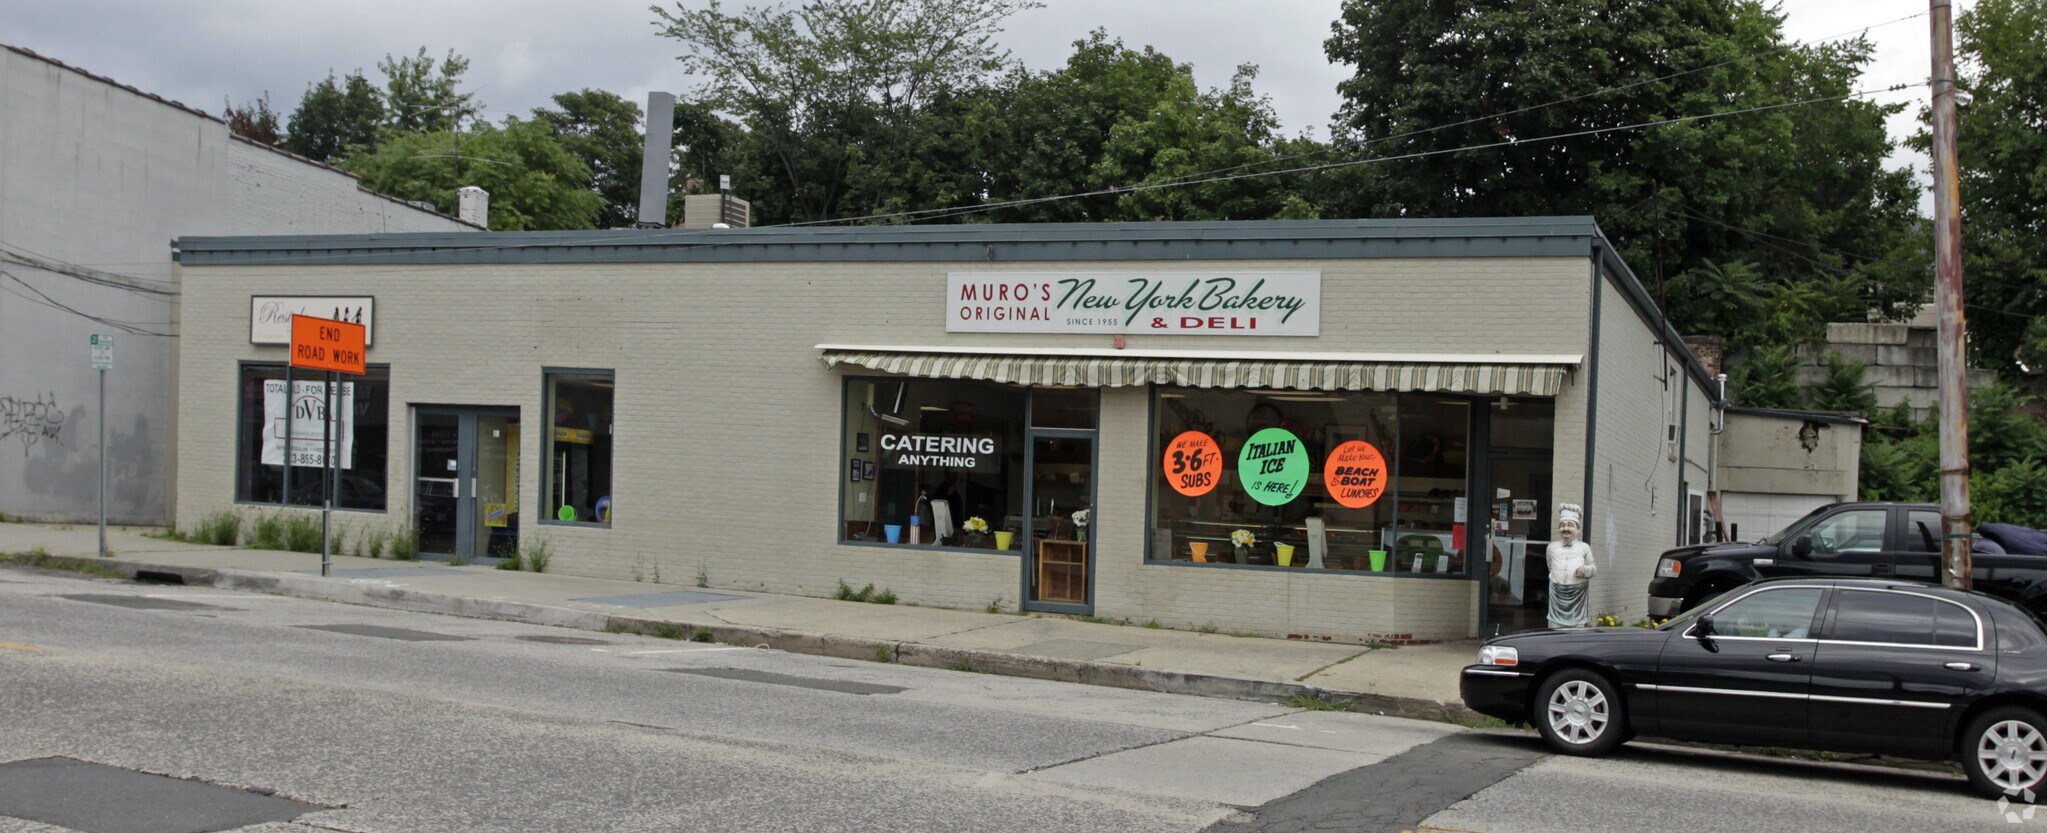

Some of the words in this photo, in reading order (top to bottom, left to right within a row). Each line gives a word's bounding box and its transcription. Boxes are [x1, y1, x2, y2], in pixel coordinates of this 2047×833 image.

[960, 283, 1051, 301] MURO'S
[1056, 278, 1121, 310] New
[1124, 278, 1200, 327] York
[1198, 277, 1306, 325] Bakery
[960, 306, 1050, 321] ORIGINAL
[1066, 318, 1093, 326] SINCE
[1097, 318, 1118, 326] 1955
[1150, 316, 1168, 329] &
[1180, 316, 1257, 329] DELI
[320, 326, 340, 342] END
[298, 344, 325, 361] ROAD
[333, 349, 360, 365] WORK
[306, 385, 323, 395] FOR
[295, 400, 327, 421] DVB
[880, 434, 994, 454] CATERING
[1176, 441, 1188, 449] WE
[1189, 439, 1209, 448] MAKE
[1246, 439, 1296, 461] ITALIAN
[898, 454, 976, 468] ANYTHING
[1259, 457, 1286, 475] ICE
[1335, 466, 1379, 477] BEACH
[1180, 471, 1212, 489] SUBS
[1251, 481, 1262, 491] IS
[1340, 477, 1376, 487] BOAT
[1340, 488, 1379, 499] LUNCHES
